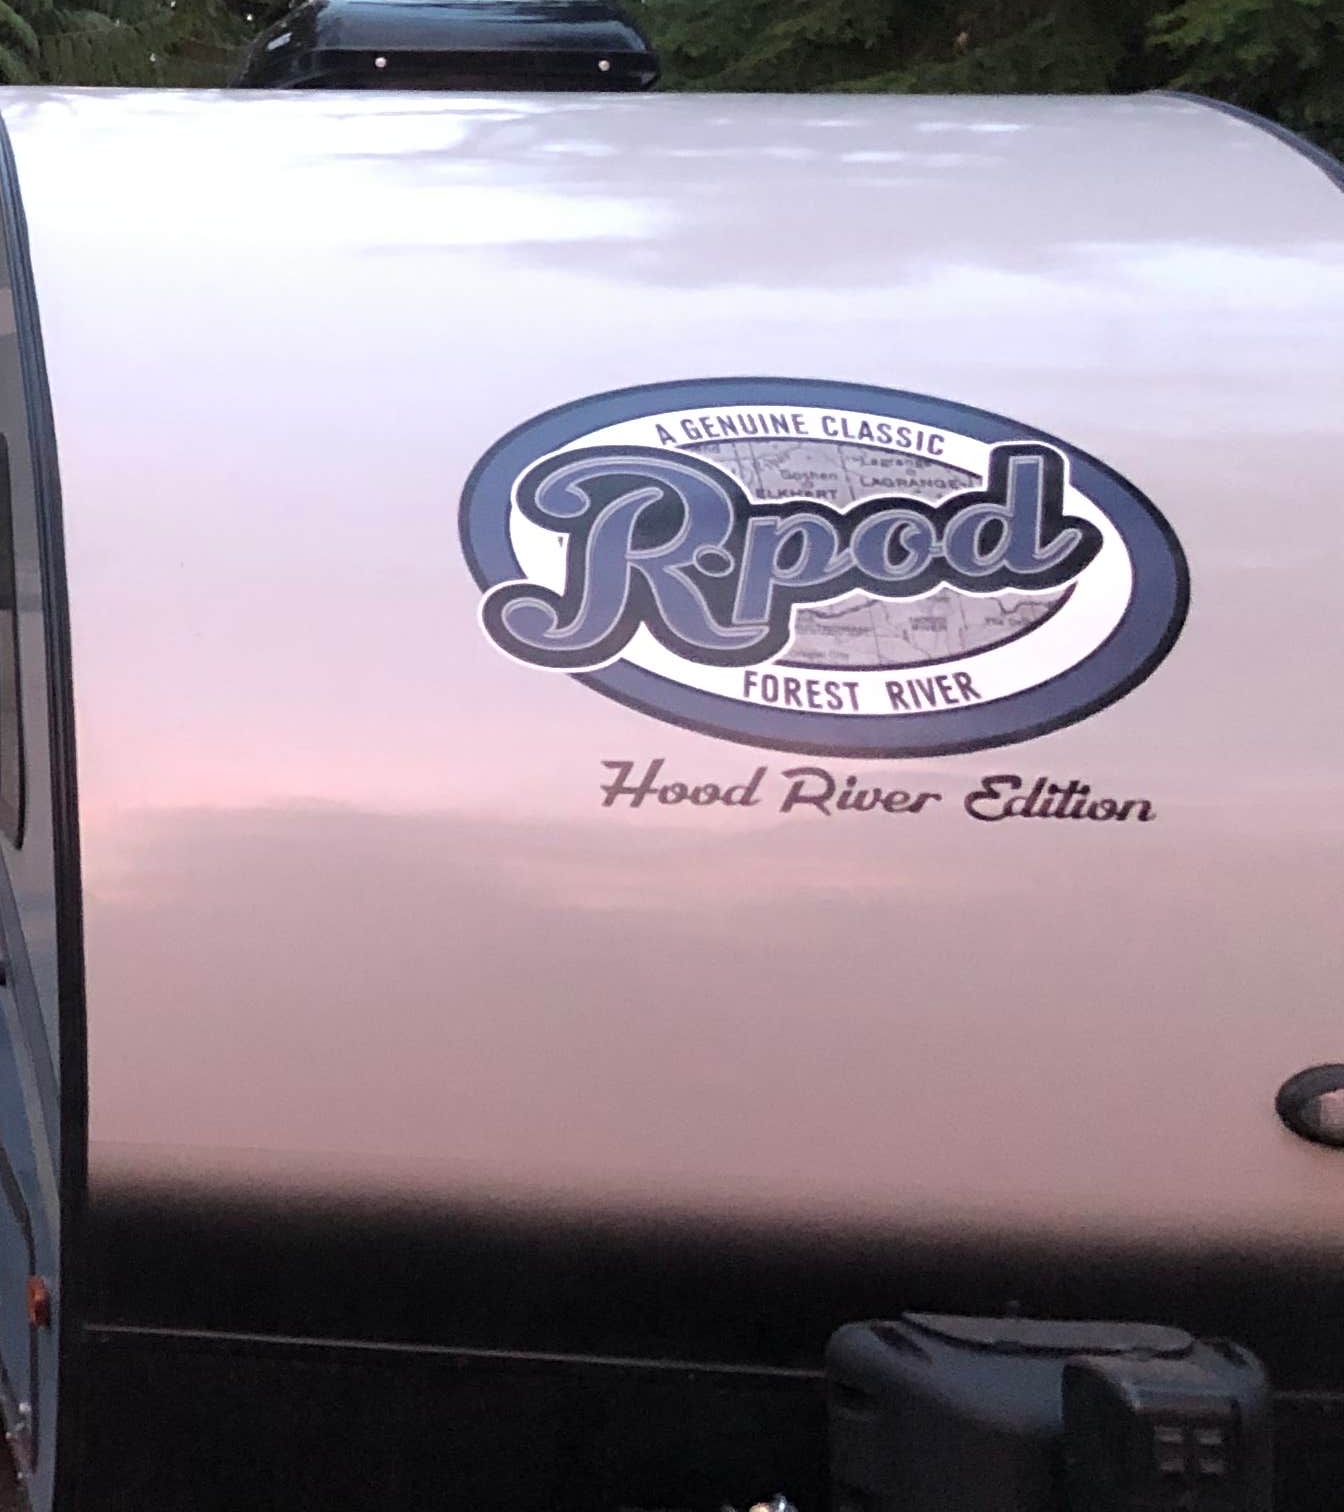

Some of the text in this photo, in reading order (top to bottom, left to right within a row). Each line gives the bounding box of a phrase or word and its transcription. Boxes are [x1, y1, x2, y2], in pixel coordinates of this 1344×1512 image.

[655, 413, 945, 455] A GENUINE CLASSIC
[743, 670, 982, 711] FOREST RIVER
[600, 757, 1156, 822] Hood River Edition
